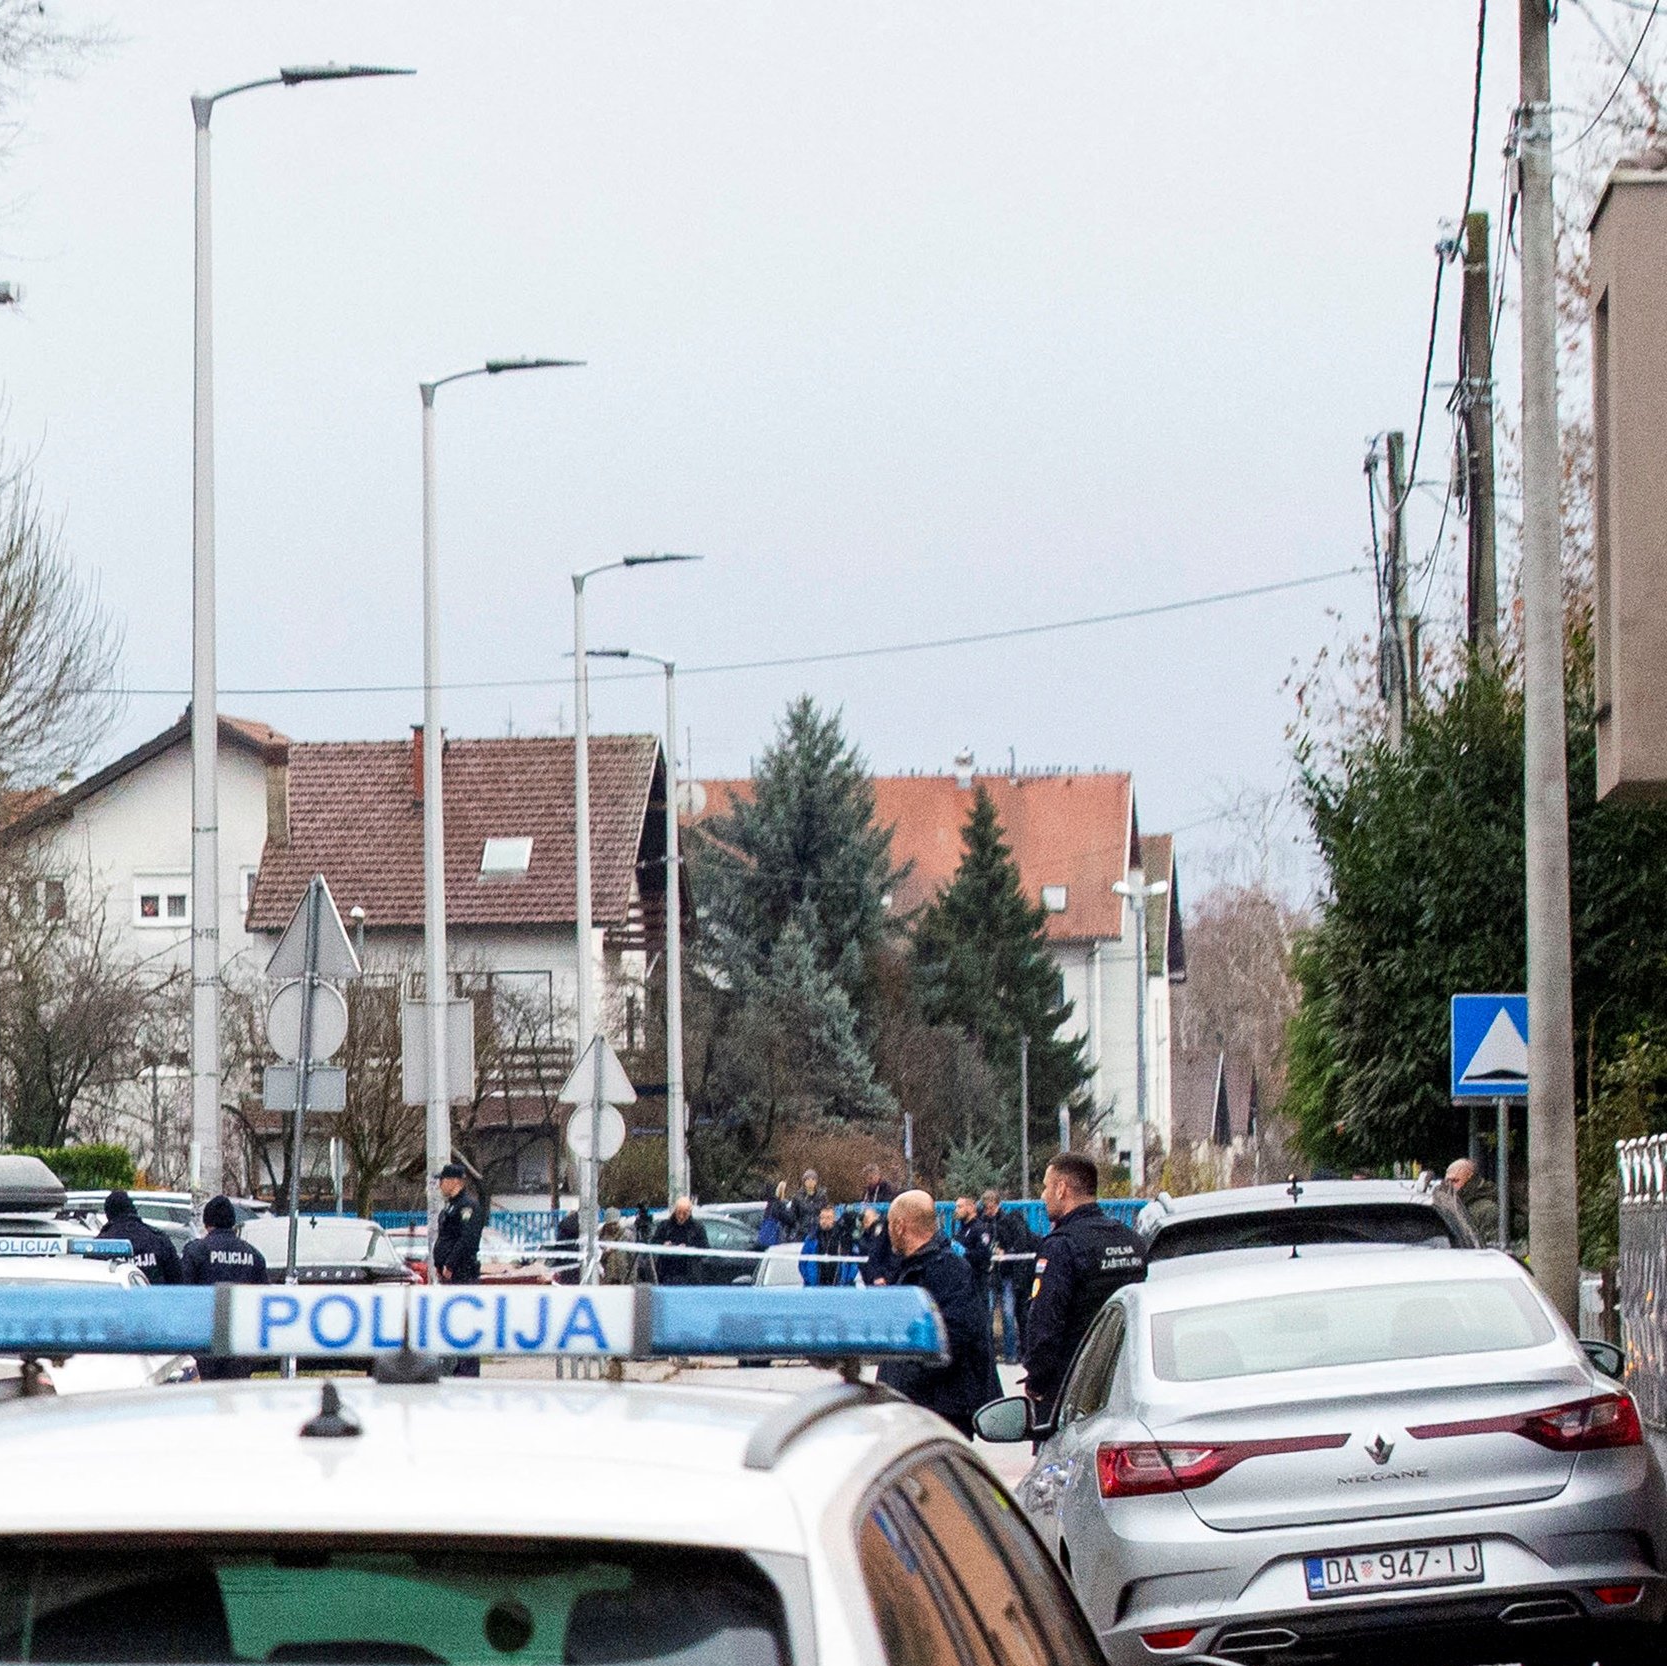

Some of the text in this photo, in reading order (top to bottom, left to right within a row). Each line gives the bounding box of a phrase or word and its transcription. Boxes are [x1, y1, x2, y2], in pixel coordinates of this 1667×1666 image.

[210, 1250, 254, 1267] POLICIJA
[259, 1295, 610, 1350] POLICIJA
[1337, 1468, 1430, 1485] MEGANE
[1326, 1557, 1358, 1585] DA
